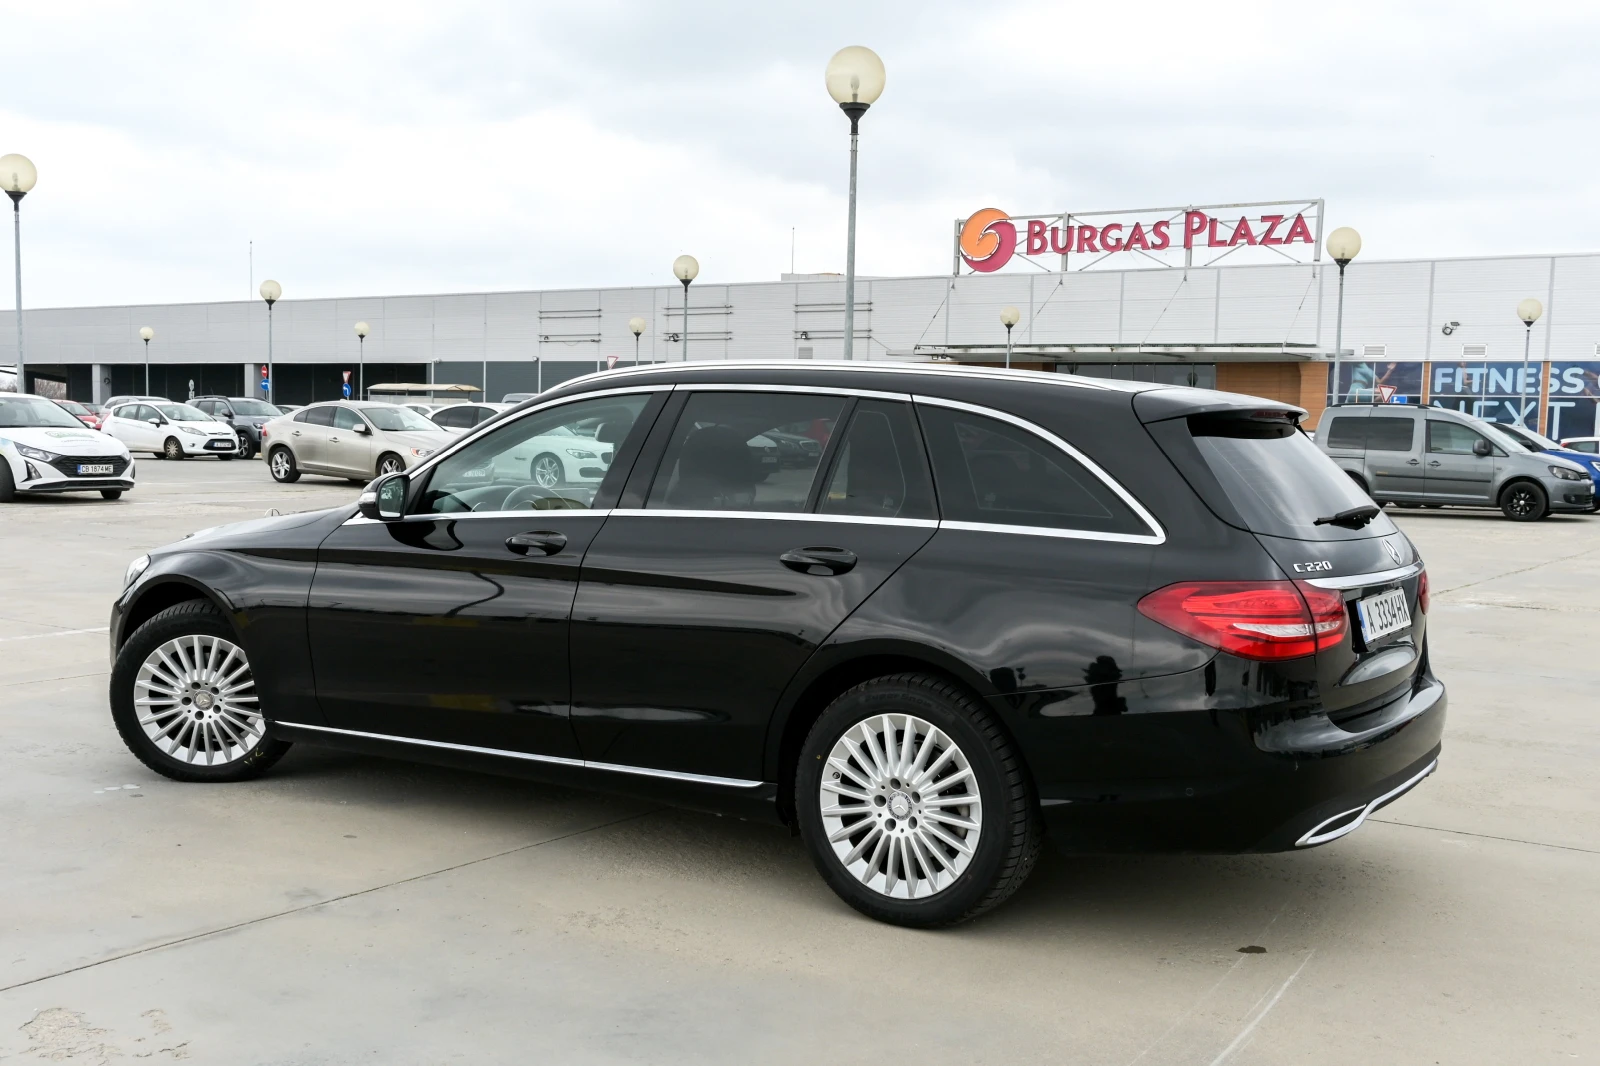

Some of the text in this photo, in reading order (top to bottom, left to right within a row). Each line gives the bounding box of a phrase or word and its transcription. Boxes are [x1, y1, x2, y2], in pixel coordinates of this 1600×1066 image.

[1027, 209, 1315, 256] BURGAS PLAZA
[1434, 366, 1585, 395] FITNESS
[81, 465, 90, 473] CB
[1293, 560, 1333, 573] C 220
